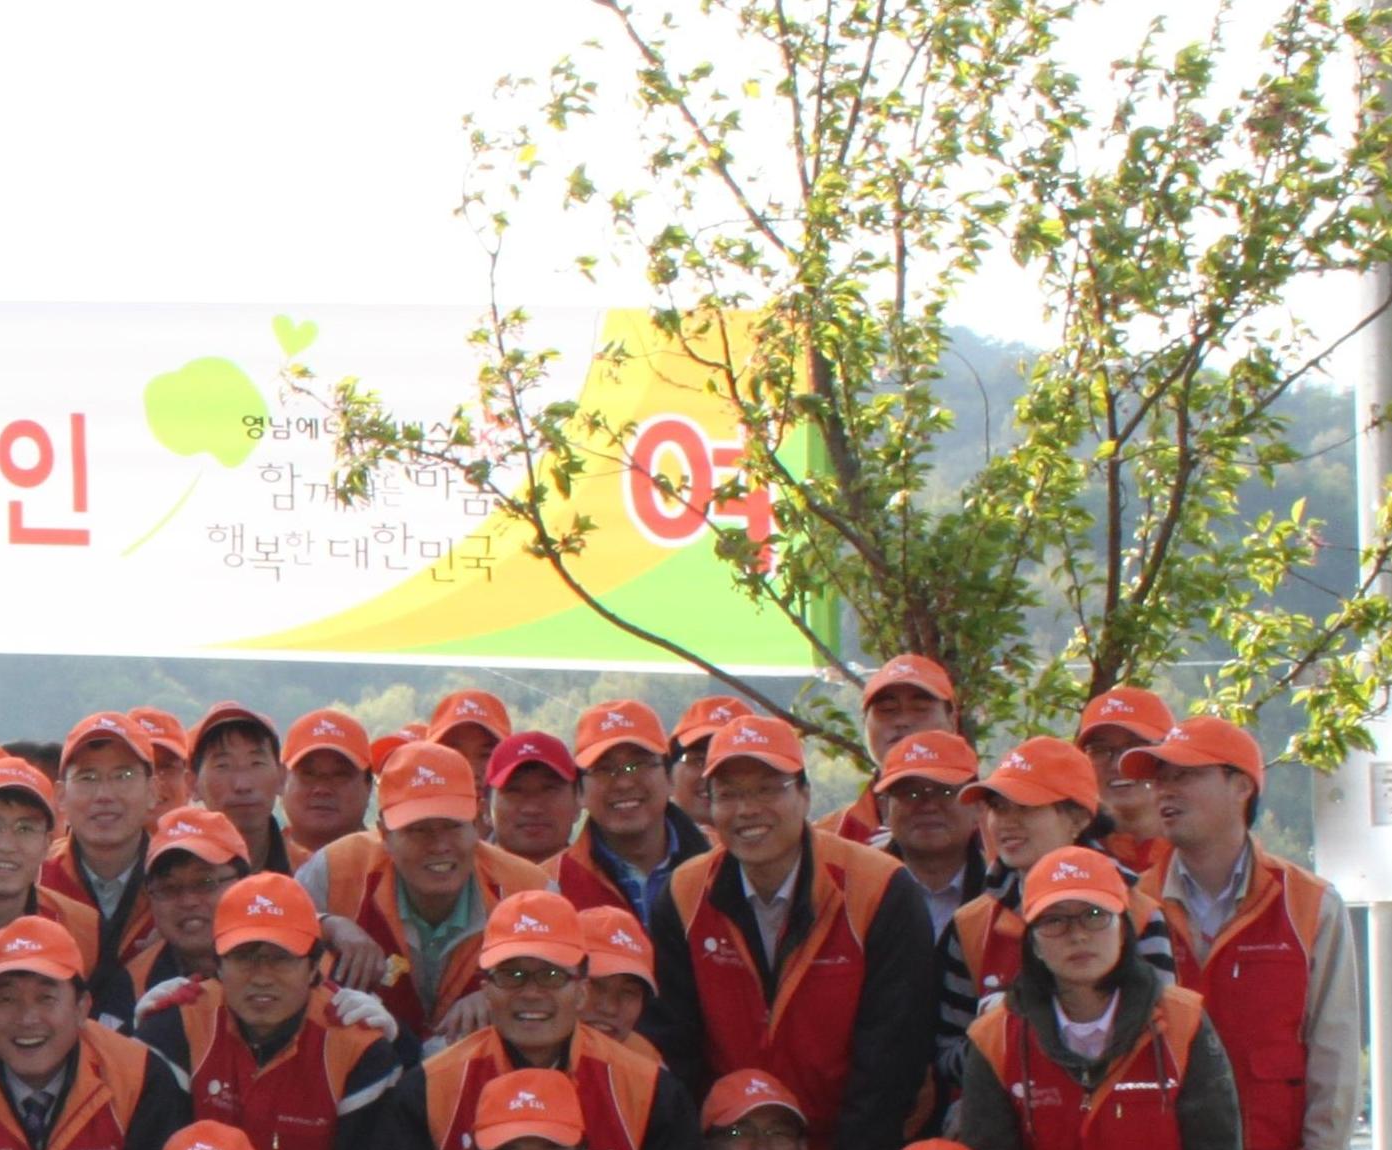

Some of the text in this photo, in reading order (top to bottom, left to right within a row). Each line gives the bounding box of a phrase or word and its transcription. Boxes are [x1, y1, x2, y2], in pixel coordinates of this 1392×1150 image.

[257, 462, 404, 513] 함께는
[206, 522, 498, 583] 행복한 대한민국
